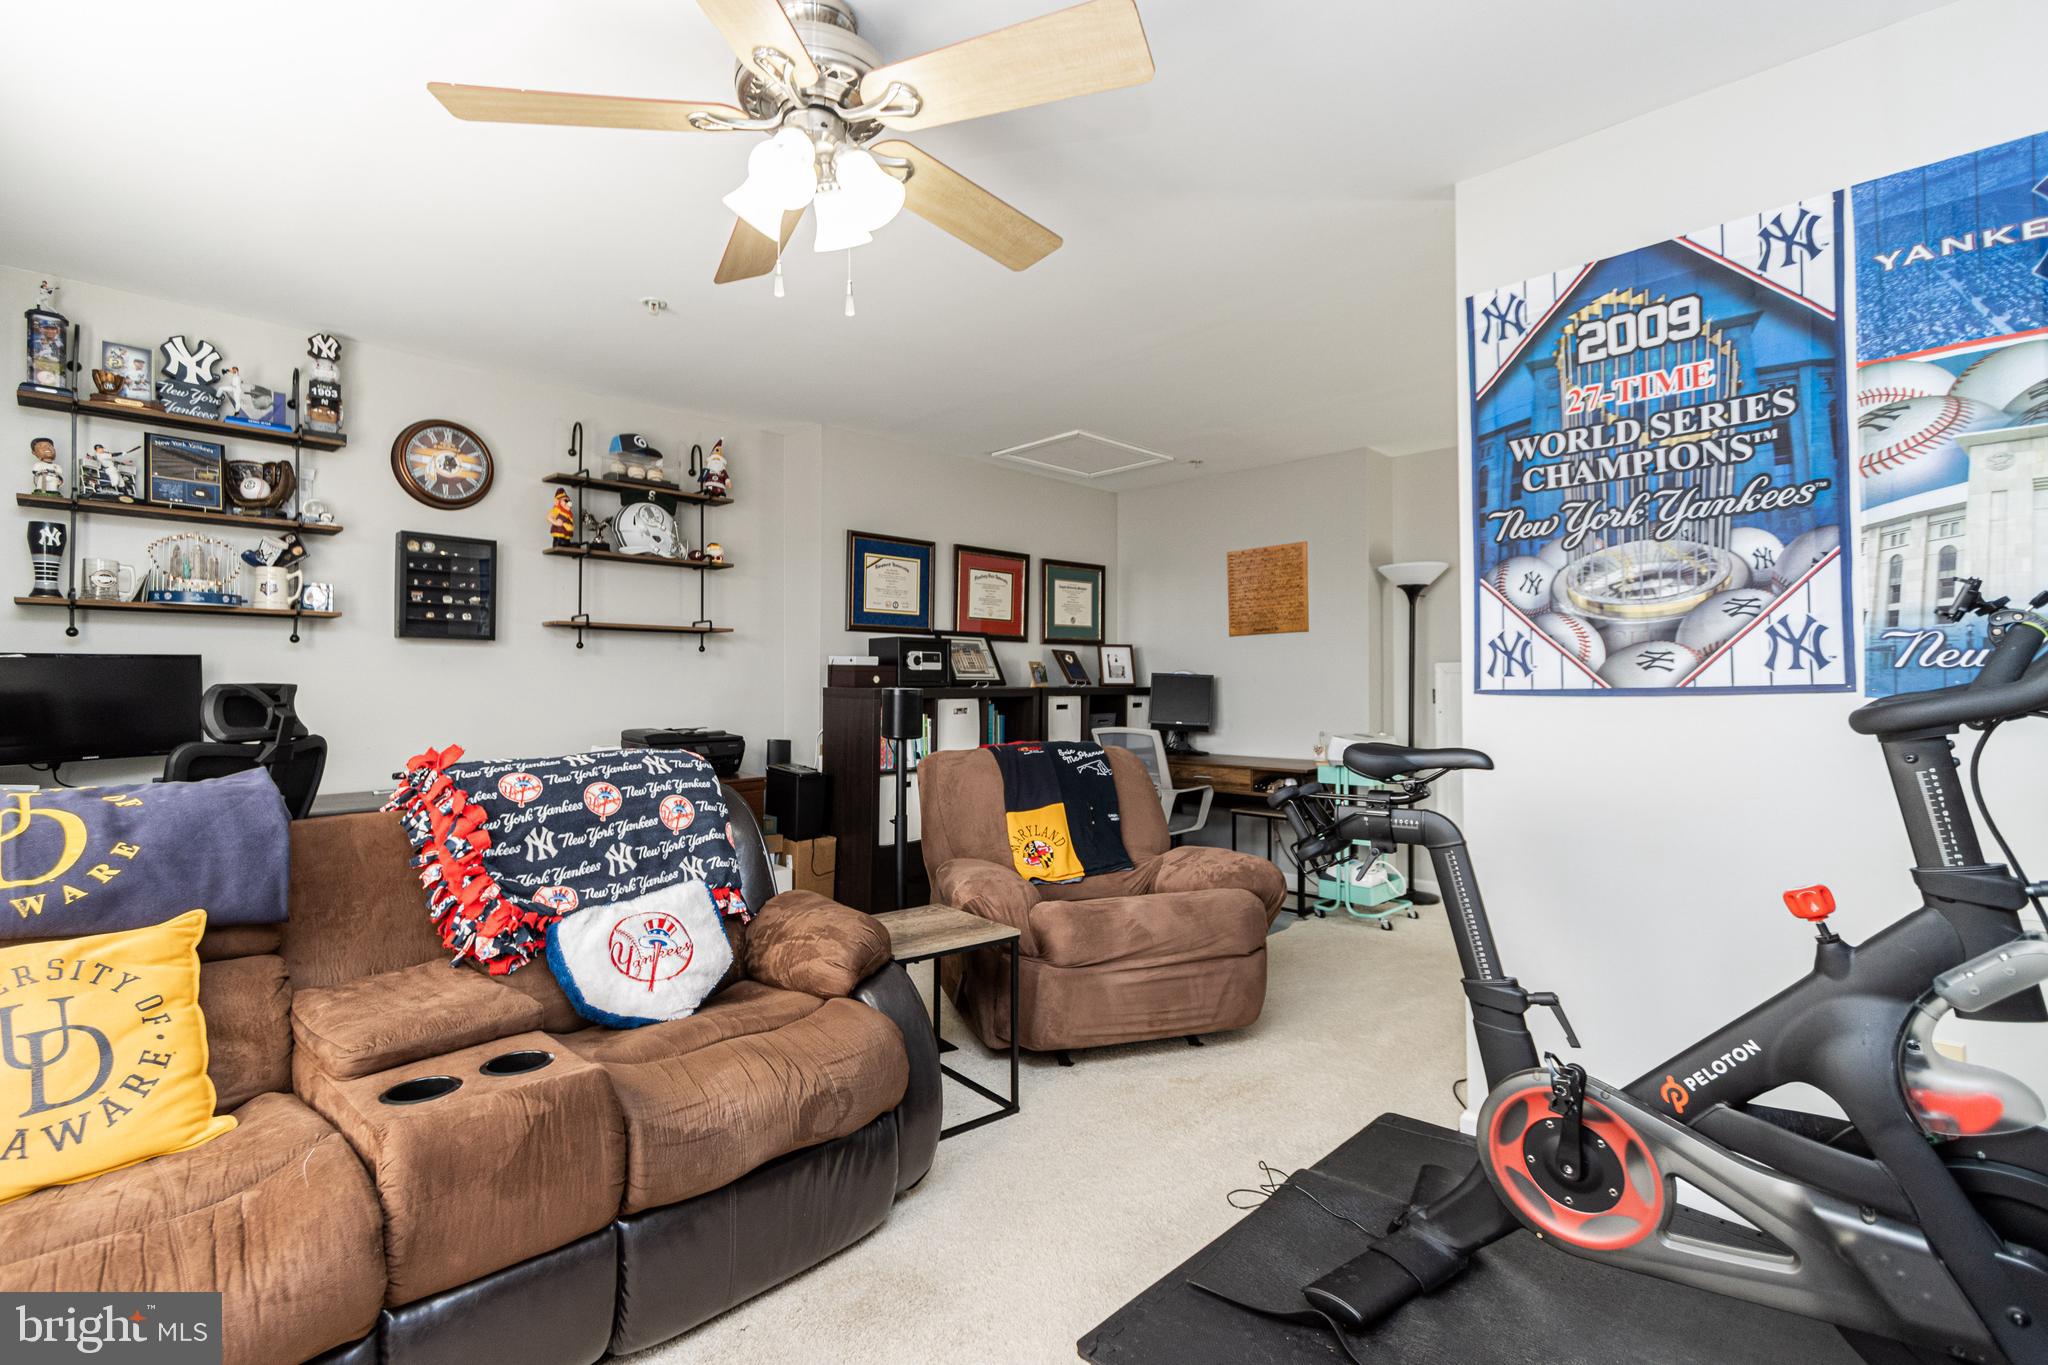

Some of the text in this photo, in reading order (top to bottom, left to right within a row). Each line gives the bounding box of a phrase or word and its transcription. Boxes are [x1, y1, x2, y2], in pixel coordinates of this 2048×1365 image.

[1577, 294, 1702, 364] 2009
[158, 382, 189, 397] New
[312, 387, 338, 398] 1903
[1565, 360, 1715, 416] 27-TIME
[161, 399, 218, 419] Yankees
[1508, 387, 1798, 464] WORLD SERIES
[171, 440, 187, 448] York
[1521, 433, 1754, 493] CHAMPIONS
[1488, 509, 1563, 544] New
[1562, 495, 1651, 551] York
[1653, 475, 1817, 541] Yankees
[449, 769, 481, 780] New
[481, 765, 512, 777] York
[543, 762, 642, 785] New York Yankees
[669, 759, 693, 768] New
[621, 779, 711, 798] New York Yankees
[479, 800, 583, 833] ew York Yankees
[695, 801, 718, 812] New
[558, 815, 659, 848] New York Yankees
[635, 827, 725, 860] New York Yankees
[1011, 825, 1066, 853] MARYLAND
[551, 861, 601, 885] Yankees
[706, 856, 730, 870] New
[580, 870, 678, 901] New York Yankees
[135, 994, 173, 1025] OF
[1683, 1039, 1762, 1092] PELOTON
